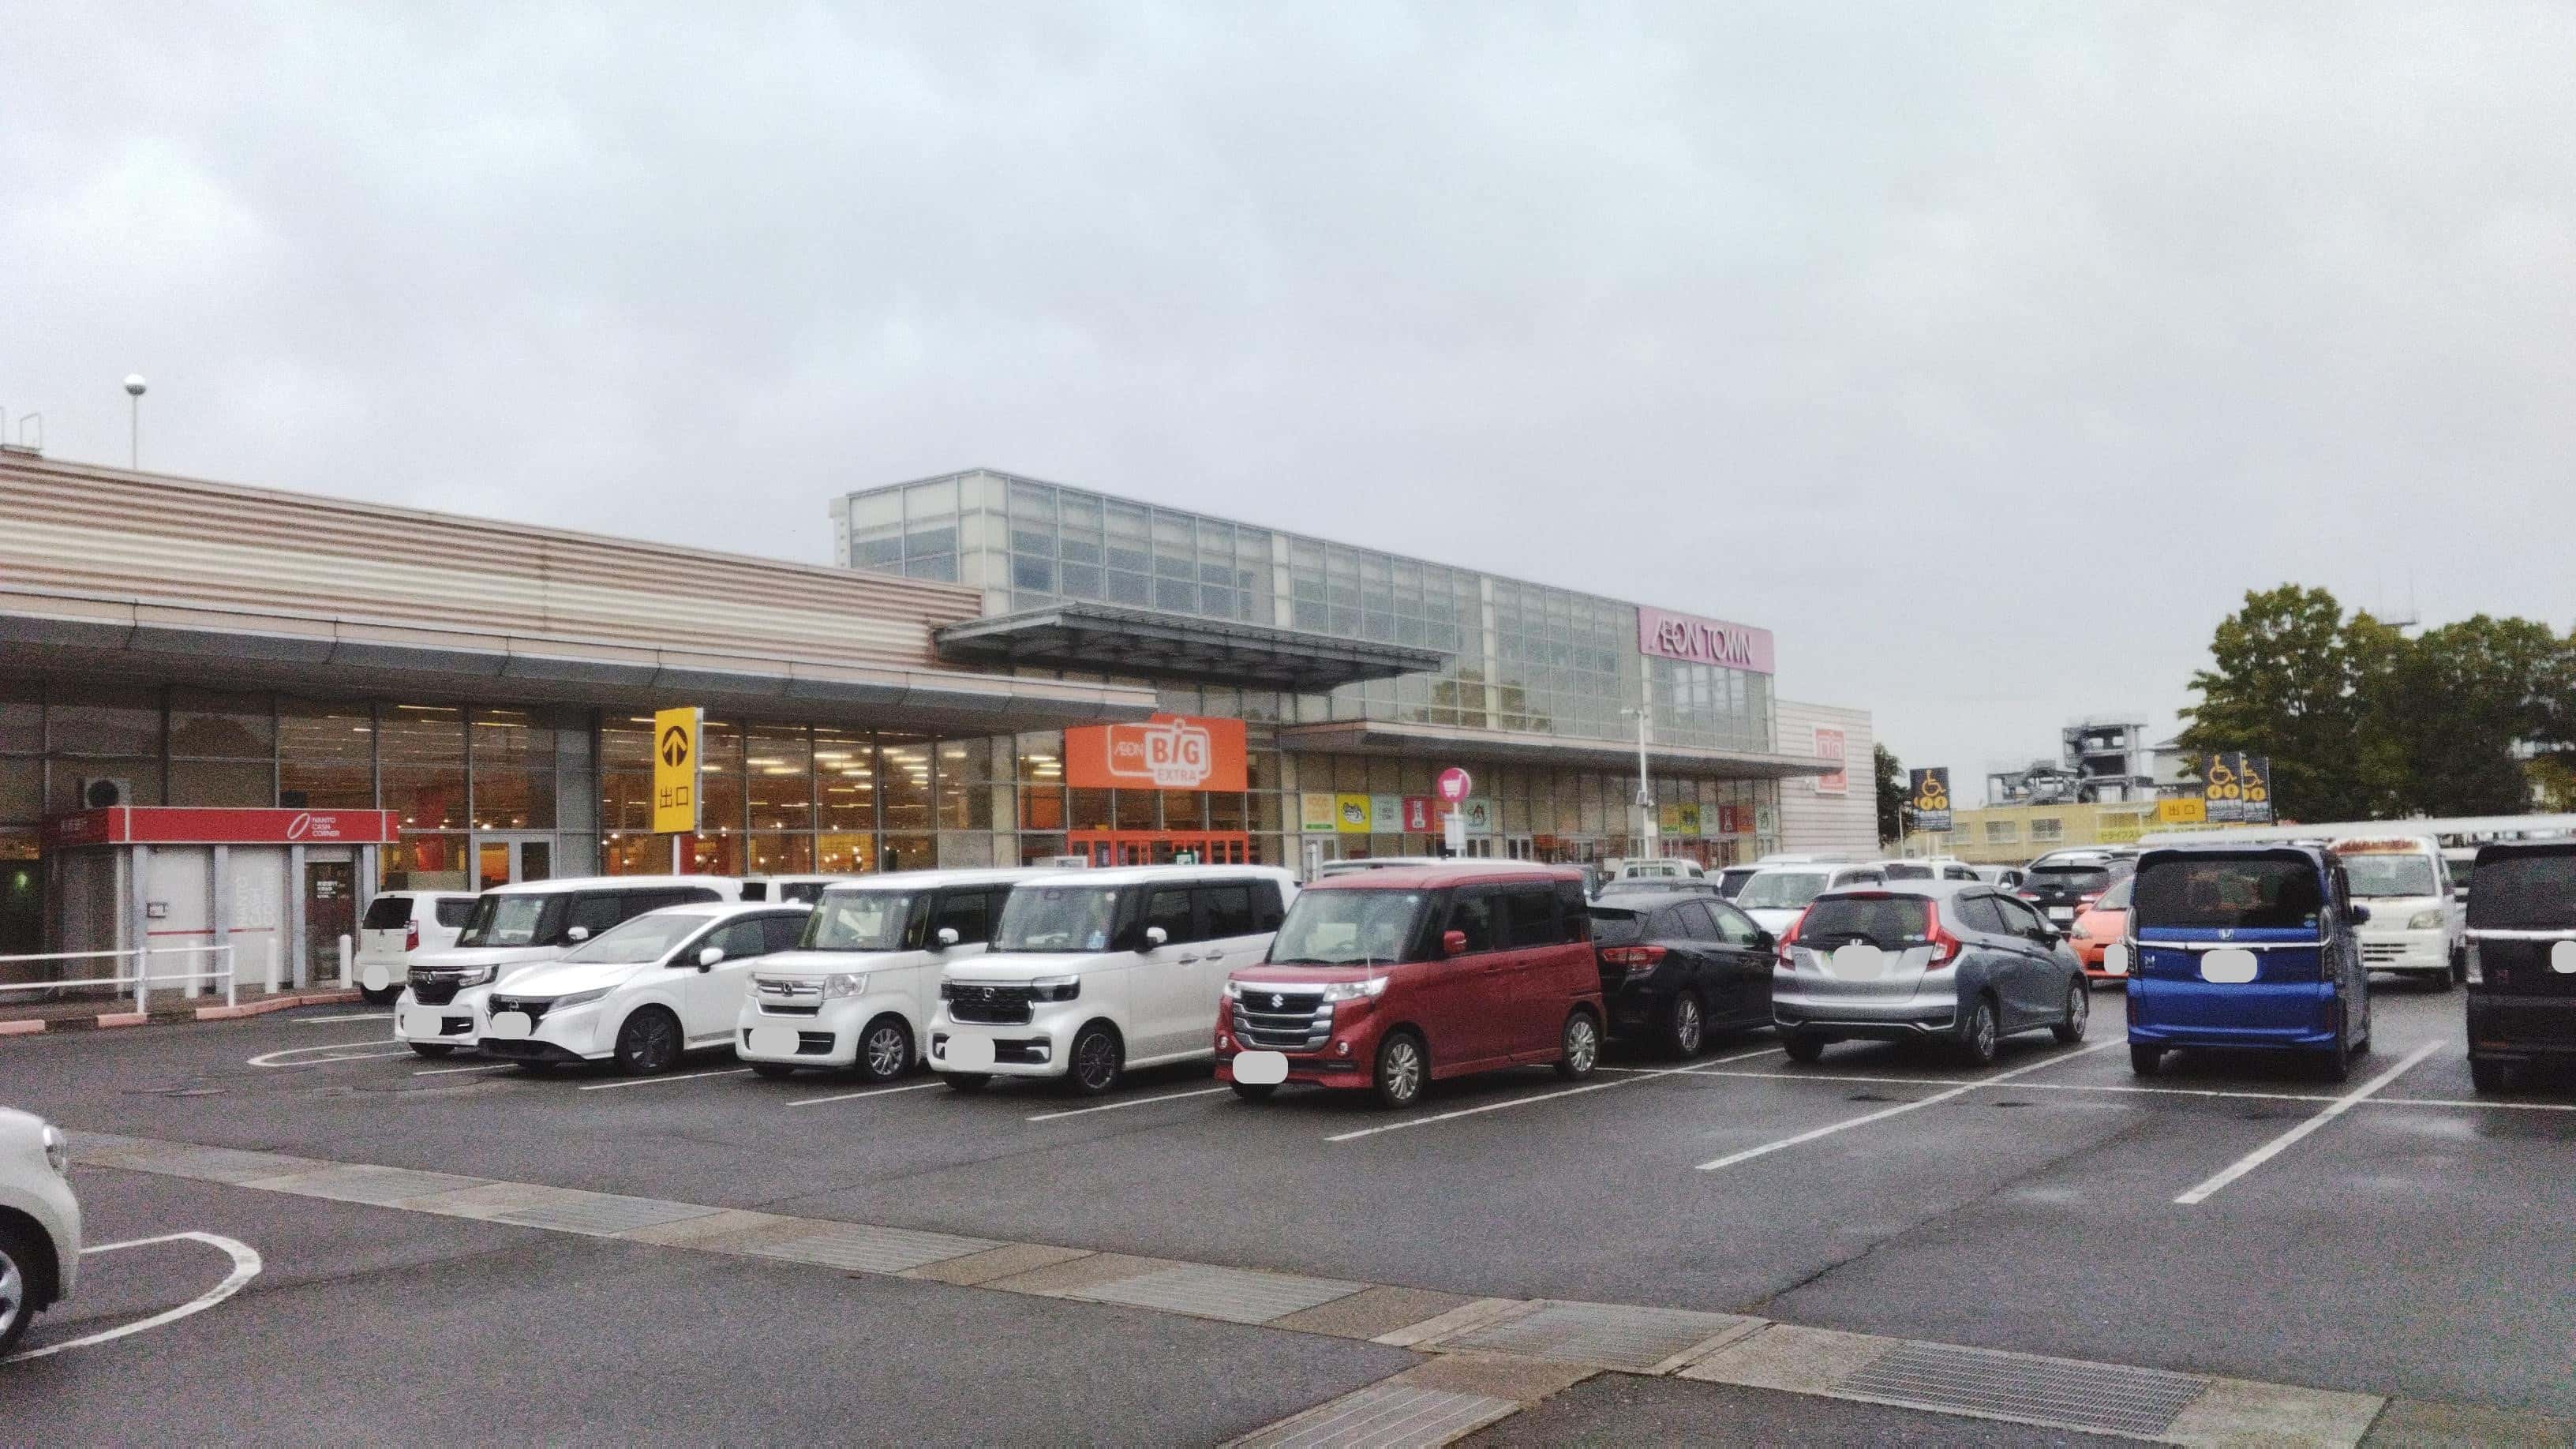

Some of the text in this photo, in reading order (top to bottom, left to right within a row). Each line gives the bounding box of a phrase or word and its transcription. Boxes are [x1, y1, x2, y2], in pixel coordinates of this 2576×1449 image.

[1702, 625, 1752, 665] TOWN
[1153, 733, 1200, 765] BIG
[1158, 769, 1197, 782] EXTRA
[660, 786, 689, 808] 出口
[2168, 804, 2196, 816] 出口
